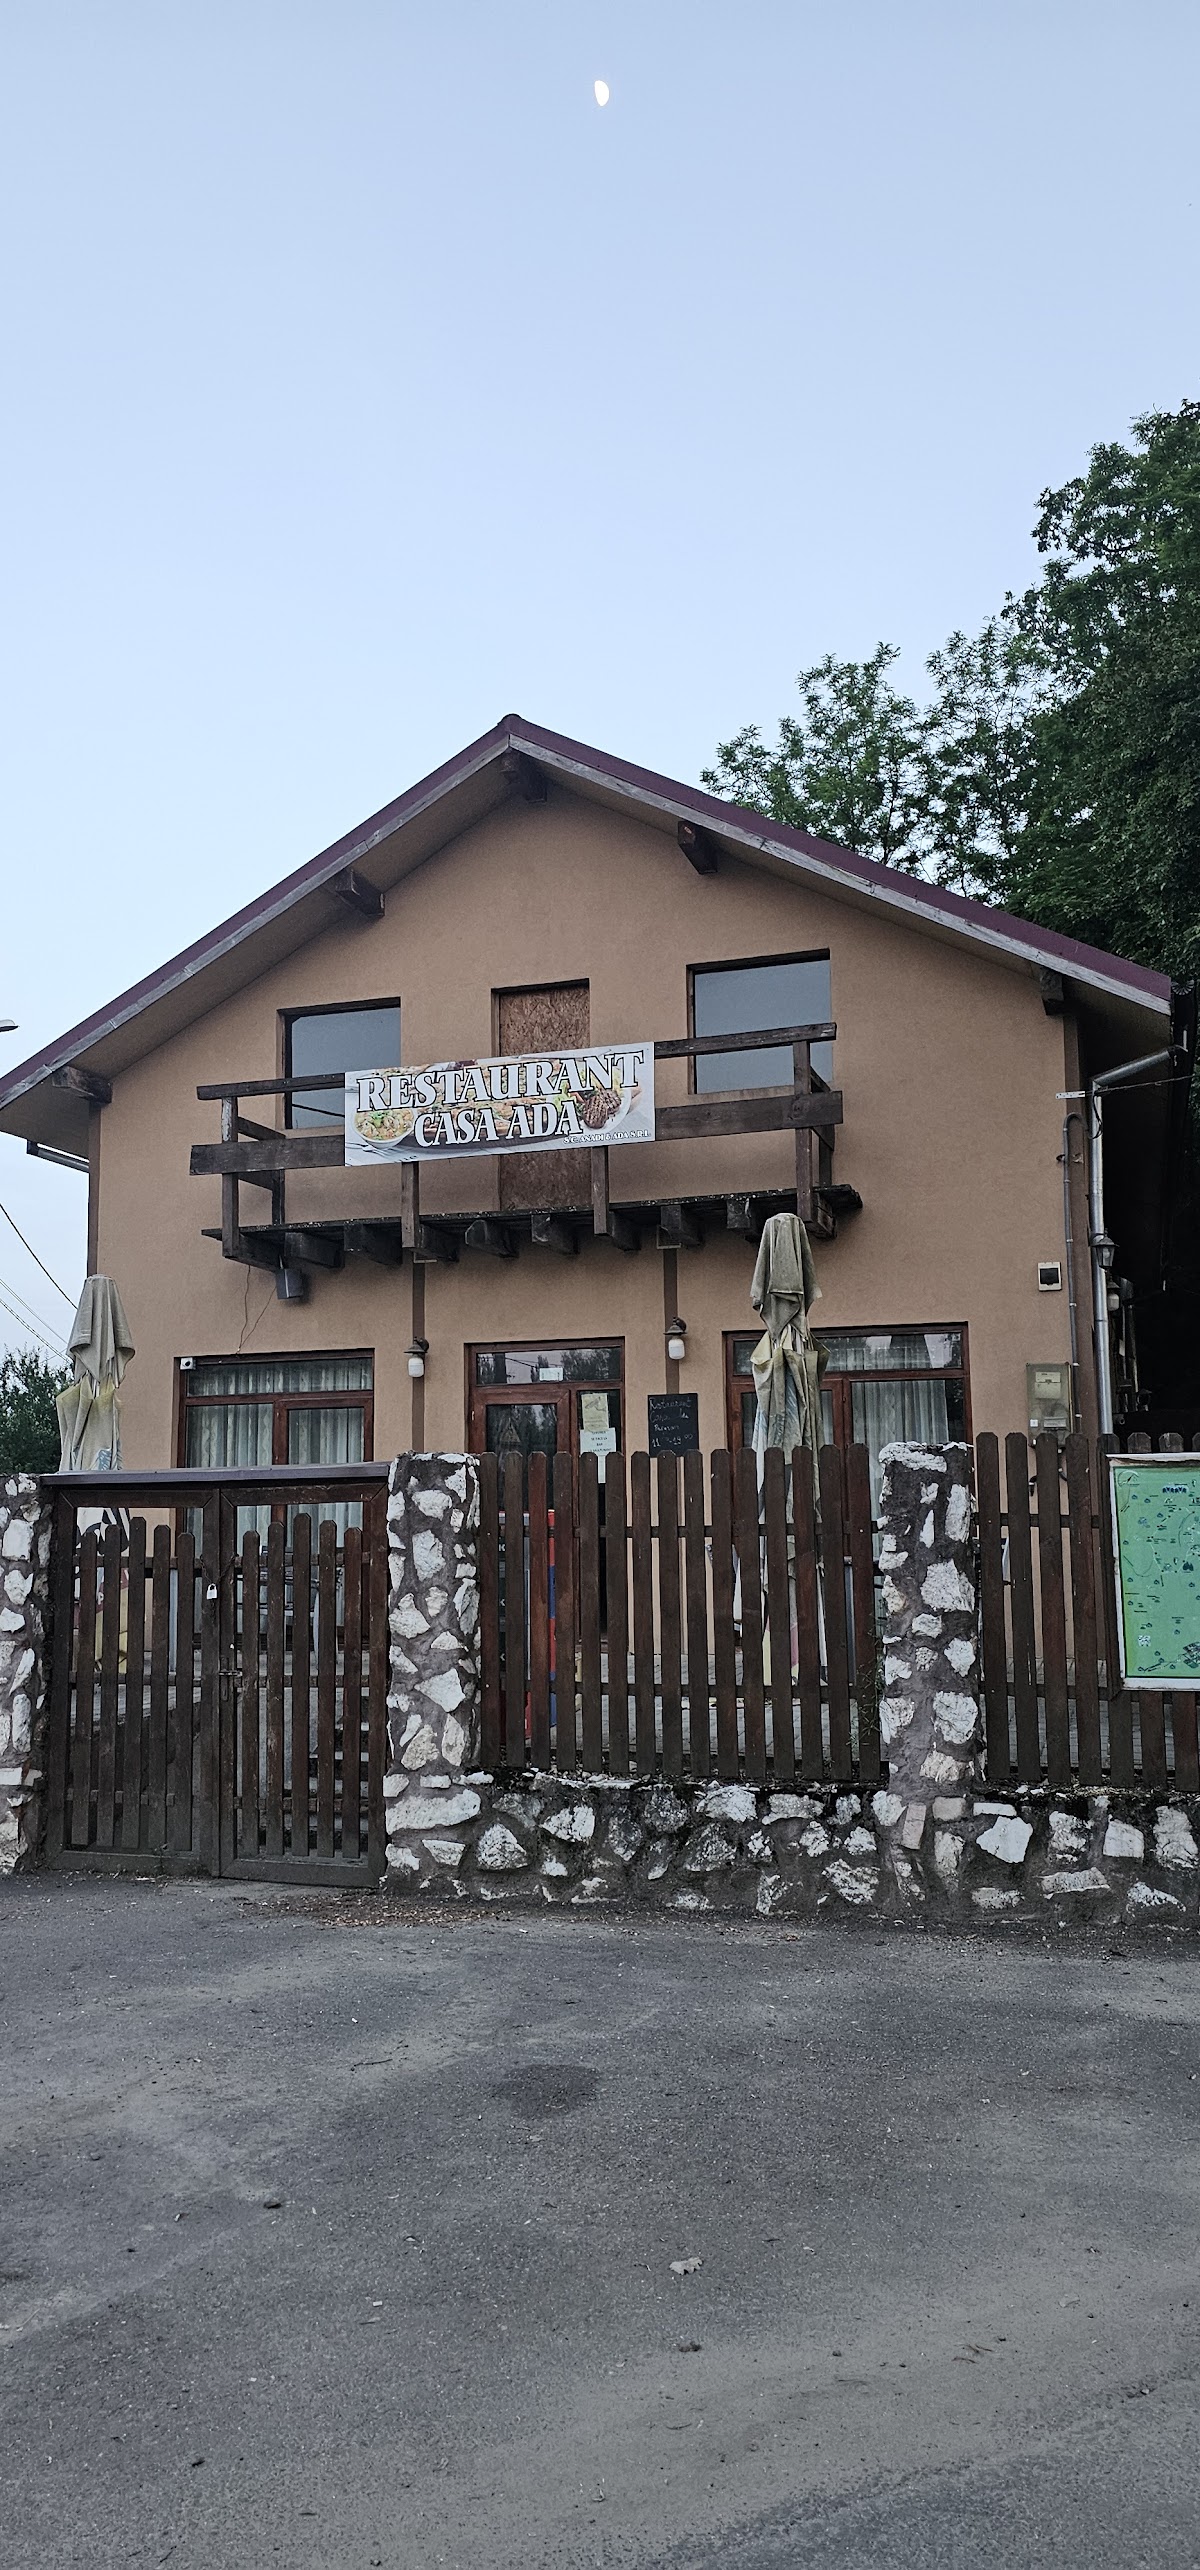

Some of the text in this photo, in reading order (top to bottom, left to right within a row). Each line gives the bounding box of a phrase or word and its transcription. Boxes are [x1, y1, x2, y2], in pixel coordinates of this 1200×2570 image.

[356, 1050, 645, 1113] RESTAURANT
[413, 1099, 584, 1148] CASA ADA
[612, 1131, 629, 1139] ADA
